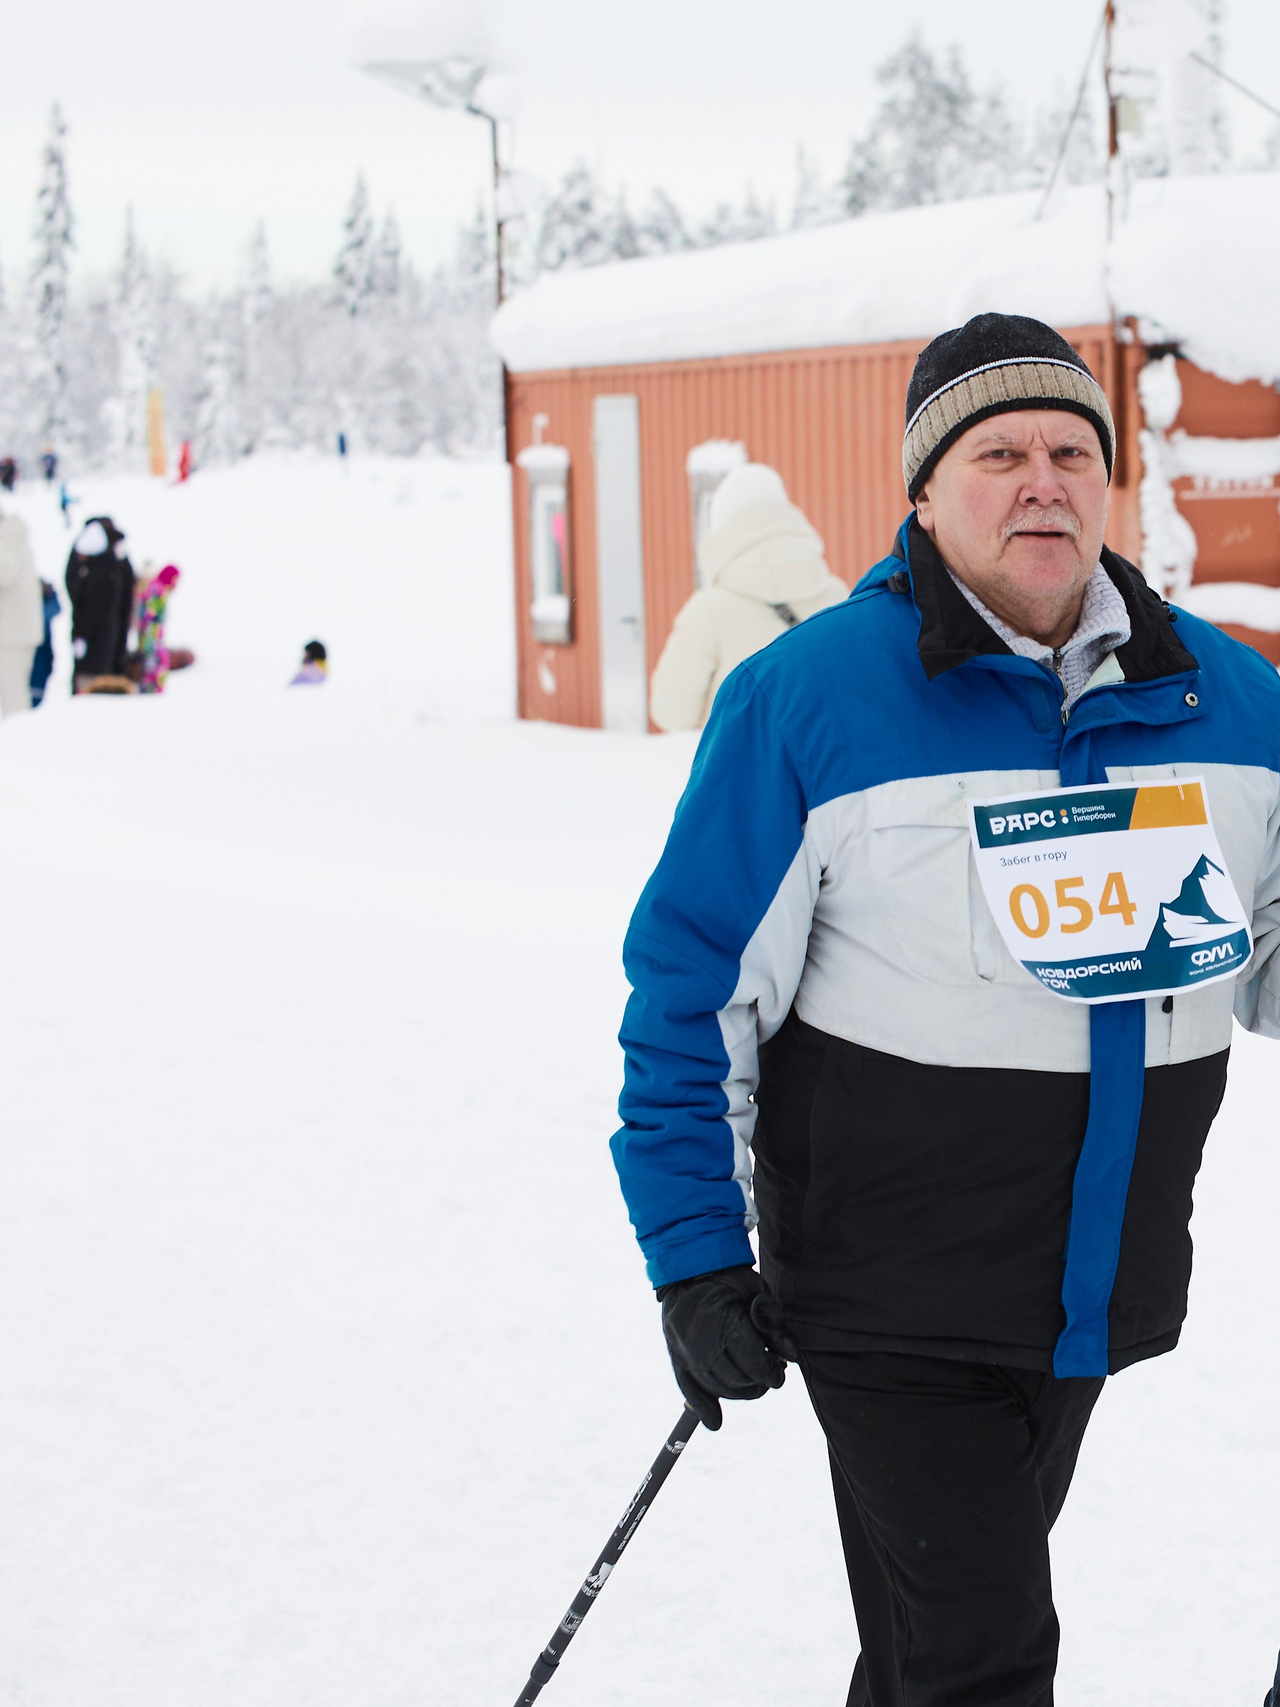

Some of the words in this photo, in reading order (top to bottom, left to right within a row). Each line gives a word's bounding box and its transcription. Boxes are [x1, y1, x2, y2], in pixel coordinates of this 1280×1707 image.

[1072, 804, 1106, 816] Вершина
[1074, 812, 1116, 823] Гипербореи
[989, 809, 1057, 836] ВАРС
[1000, 854, 1031, 867] Забег
[1034, 854, 1041, 862] в
[1043, 850, 1068, 862] гору
[1009, 871, 1137, 939] 054
[1036, 957, 1142, 980] КОВДОРСКИЙ
[1042, 978, 1071, 989] ГОК
